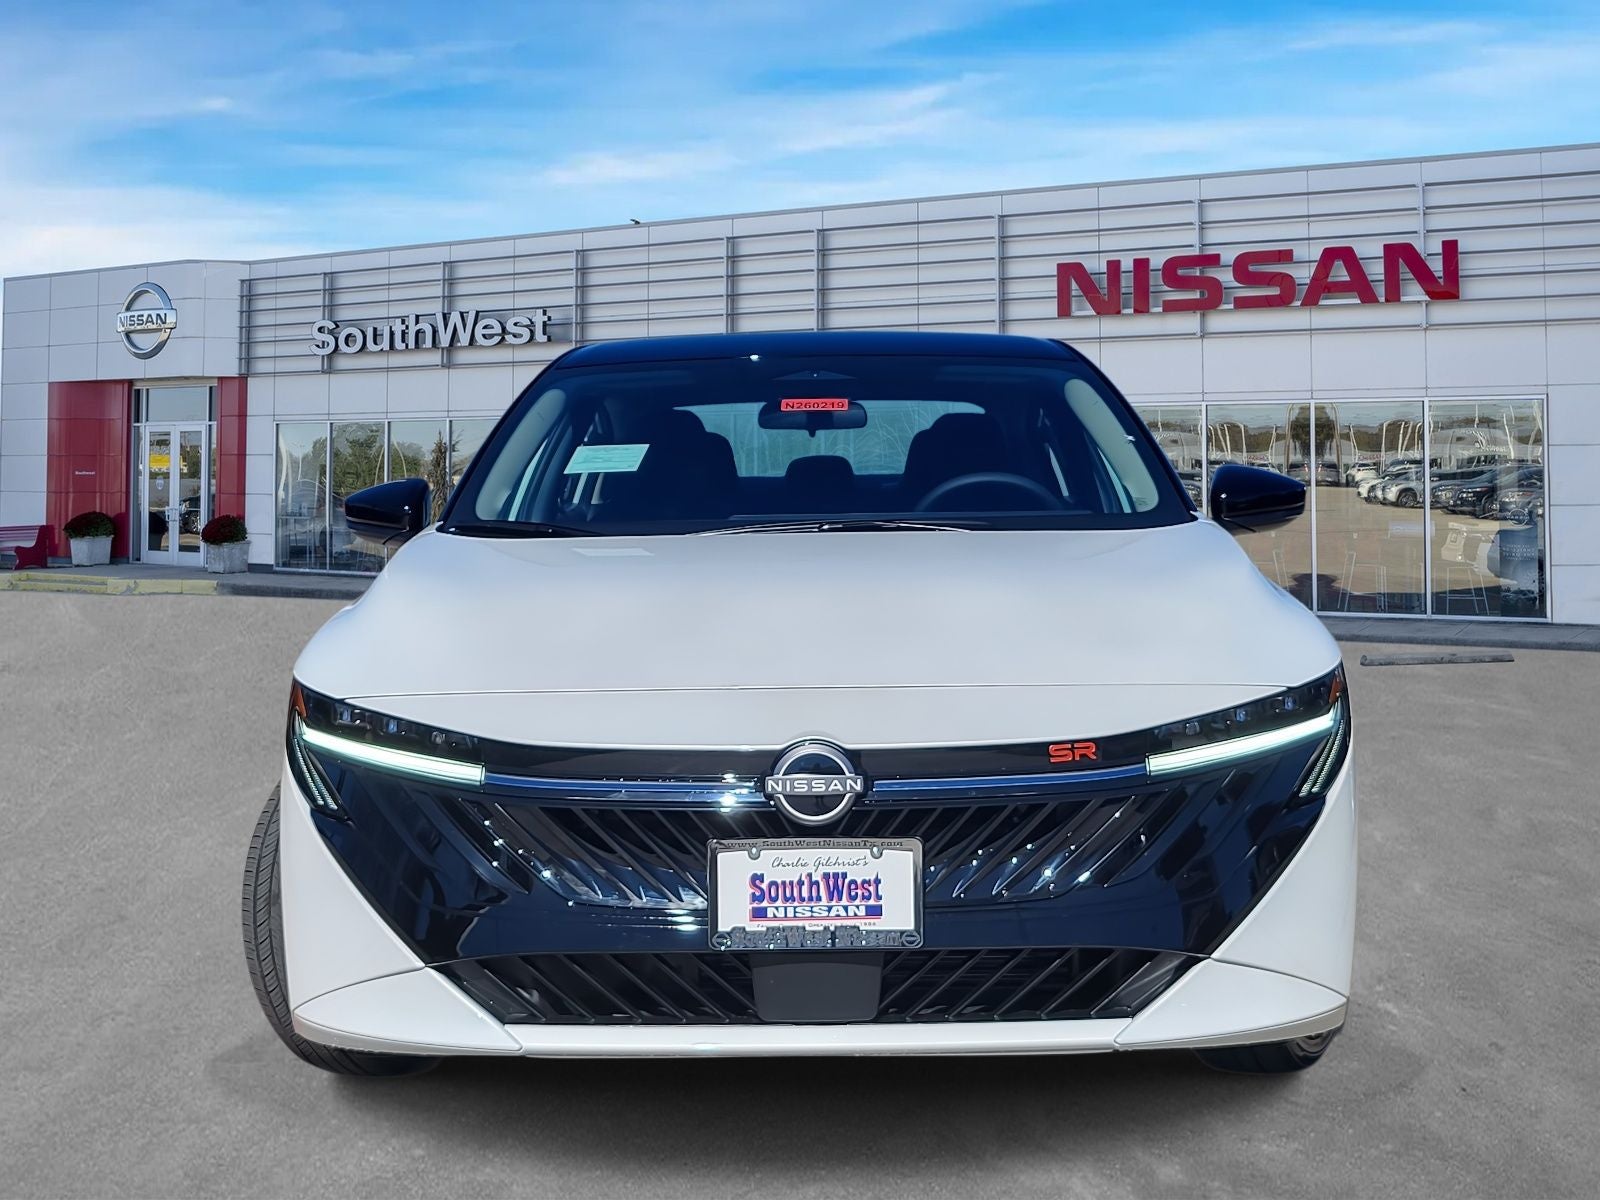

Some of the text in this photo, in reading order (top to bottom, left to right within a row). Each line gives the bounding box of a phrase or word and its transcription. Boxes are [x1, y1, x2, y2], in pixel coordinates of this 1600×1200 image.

[1056, 239, 1461, 318] NISSAN
[119, 312, 167, 328] NISSAN
[310, 308, 552, 356] SouthWest
[785, 401, 845, 409] N260219
[1049, 742, 1097, 762] SR
[767, 779, 861, 792] NISSAN
[771, 855, 869, 872] Charlie Gilchrist's
[749, 871, 883, 904] SouthWest
[766, 905, 867, 918] NISSAN
